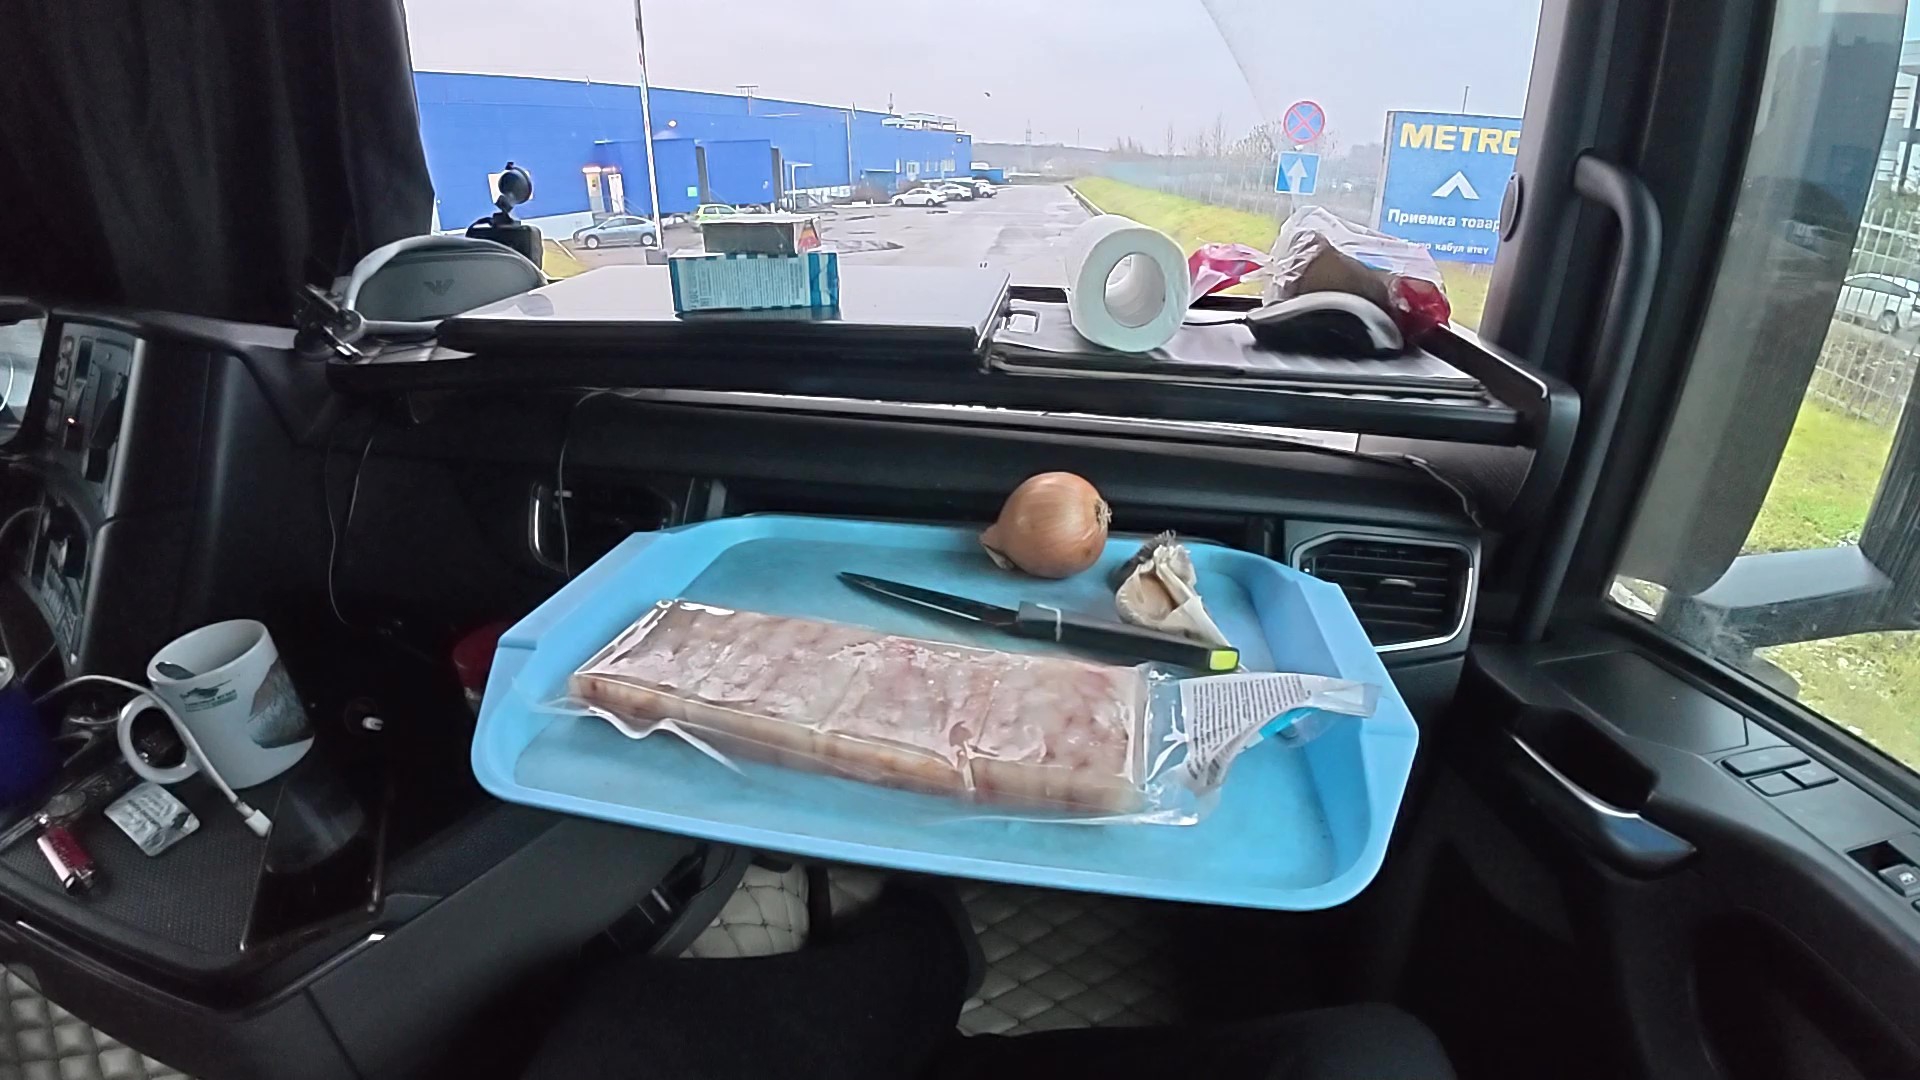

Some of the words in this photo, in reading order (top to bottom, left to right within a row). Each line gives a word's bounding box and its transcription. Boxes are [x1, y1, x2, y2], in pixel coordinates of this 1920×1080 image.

[1400, 123, 1520, 155] METRO
[1388, 209, 1456, 226] Приемка
[1461, 217, 1500, 232] товар
